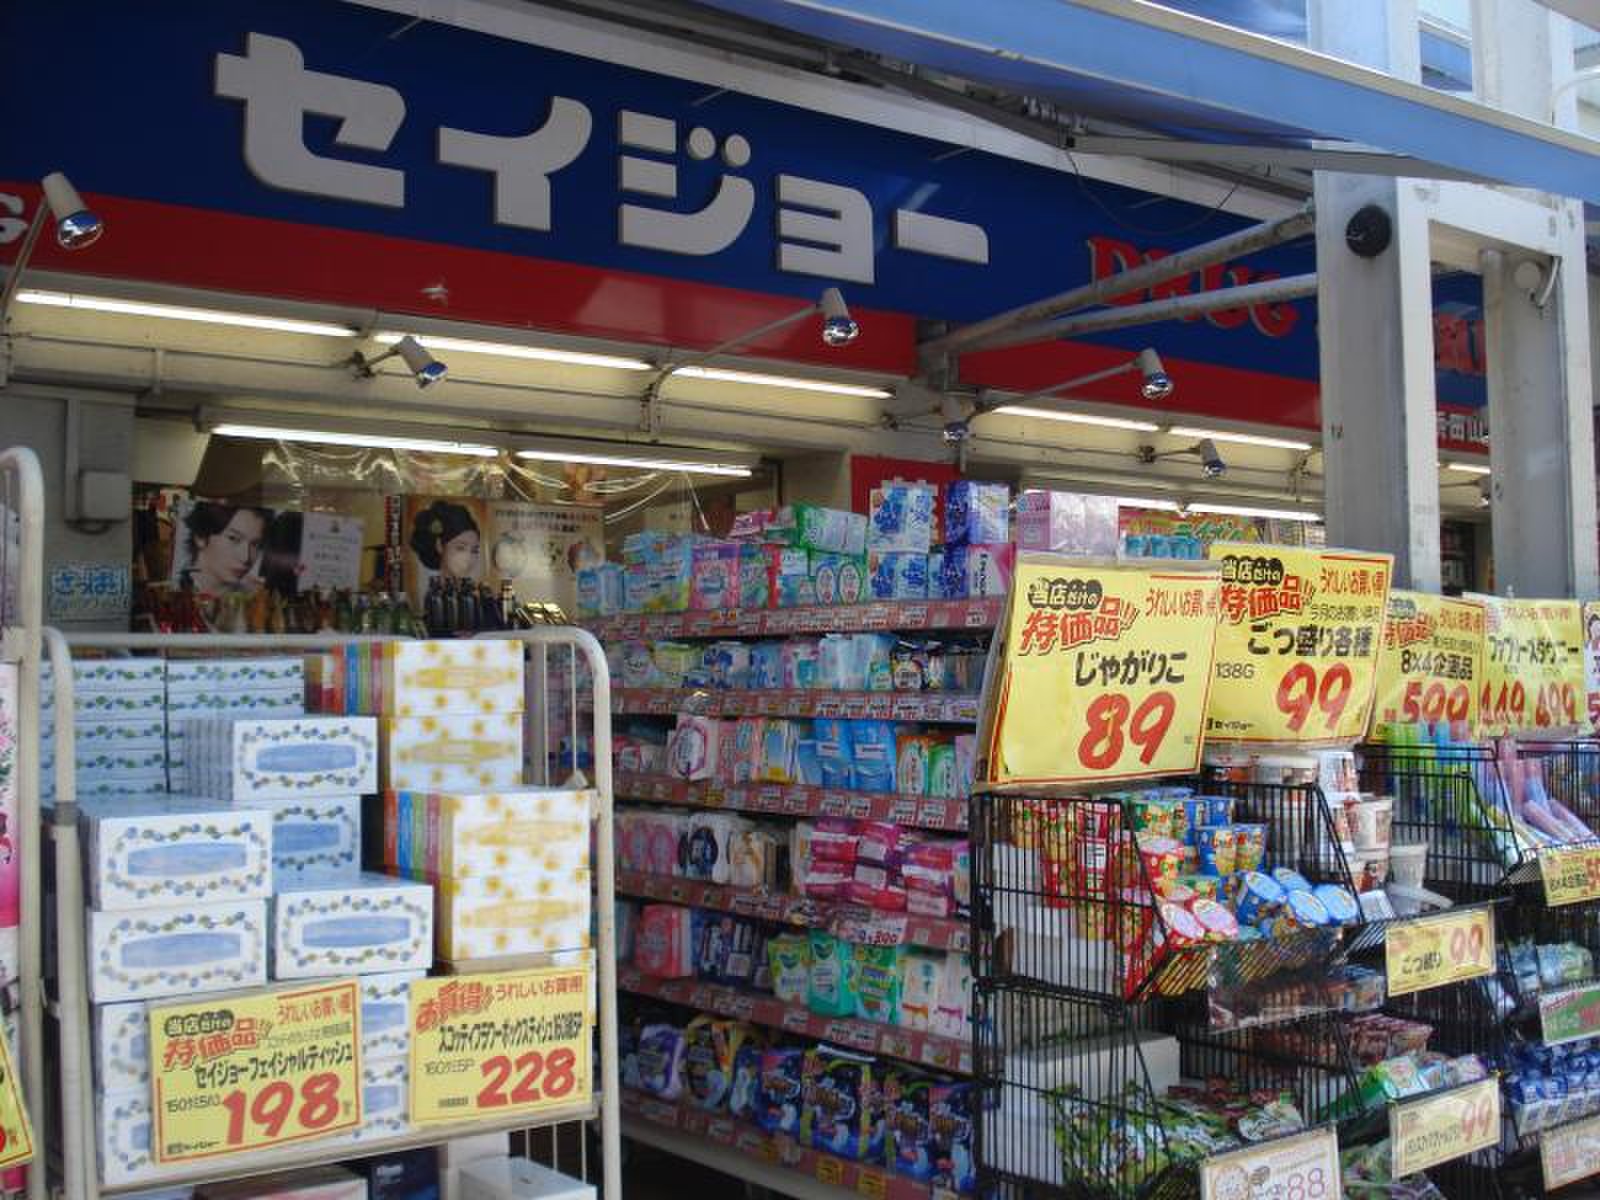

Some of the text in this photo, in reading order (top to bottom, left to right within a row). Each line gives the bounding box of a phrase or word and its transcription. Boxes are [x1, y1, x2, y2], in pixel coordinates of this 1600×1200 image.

[214, 31, 989, 284] セイジョー
[1074, 650, 1187, 687] じゃがりこ
[1215, 662, 1255, 680] 138G
[1248, 622, 1373, 657] ごつ盛り各種
[1078, 690, 1177, 770] 89
[1275, 661, 1354, 733] 99
[222, 1071, 341, 1145] 198
[476, 1047, 577, 1108] 228
